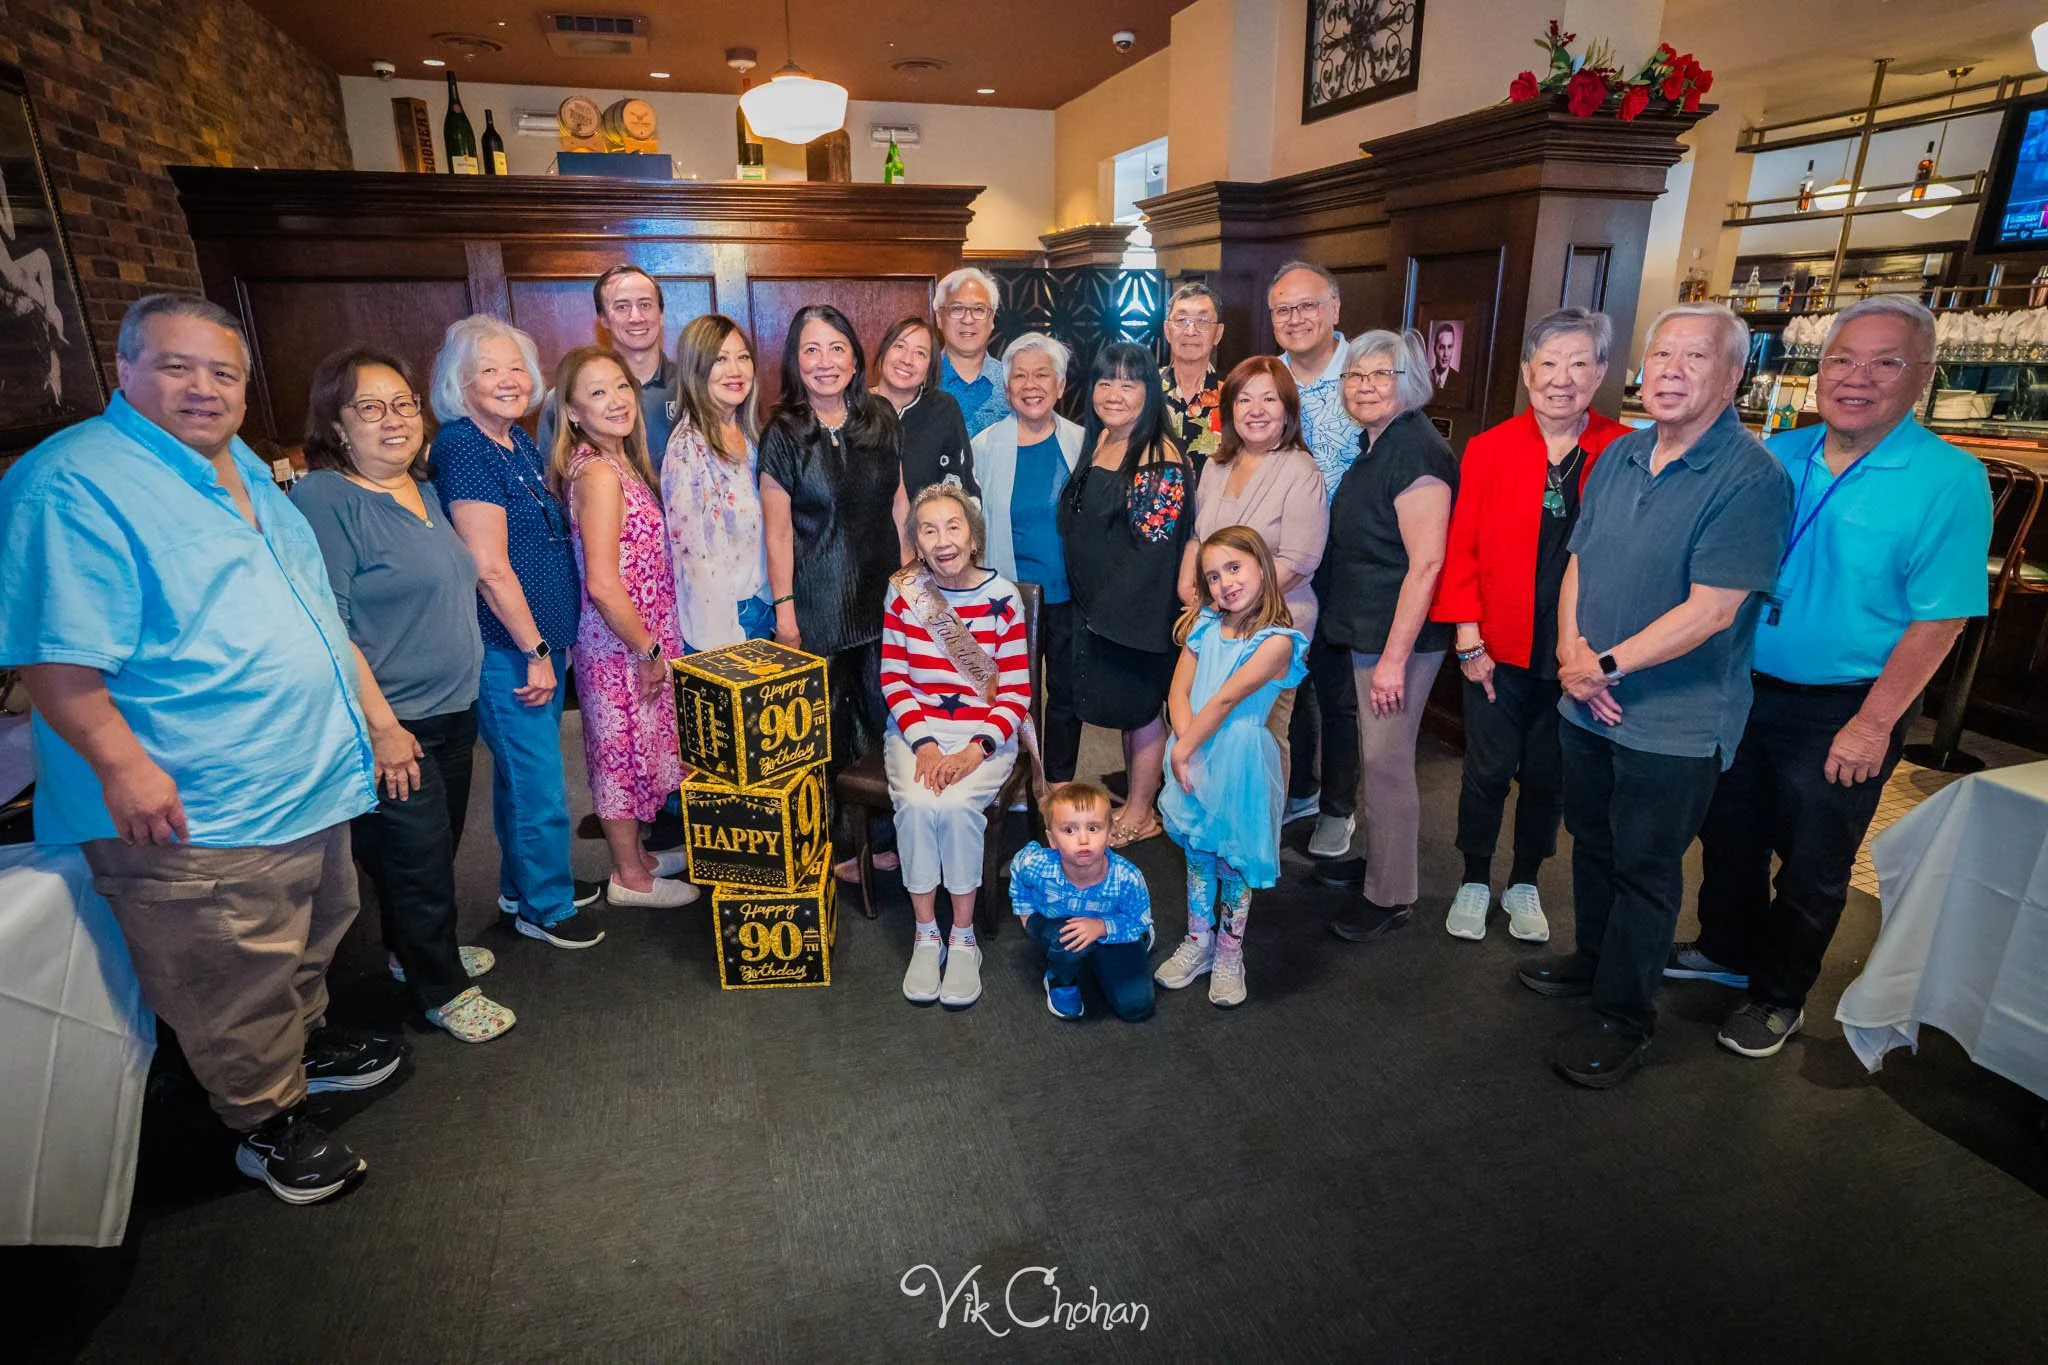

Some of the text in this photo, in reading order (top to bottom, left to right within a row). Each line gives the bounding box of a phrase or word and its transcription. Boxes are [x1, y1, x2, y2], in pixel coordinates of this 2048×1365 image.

[760, 677, 810, 706] Happy
[759, 742, 815, 776] Birthday
[691, 823, 781, 856] HAPPY
[740, 903, 799, 921] Happy
[740, 962, 807, 982] Birthday
